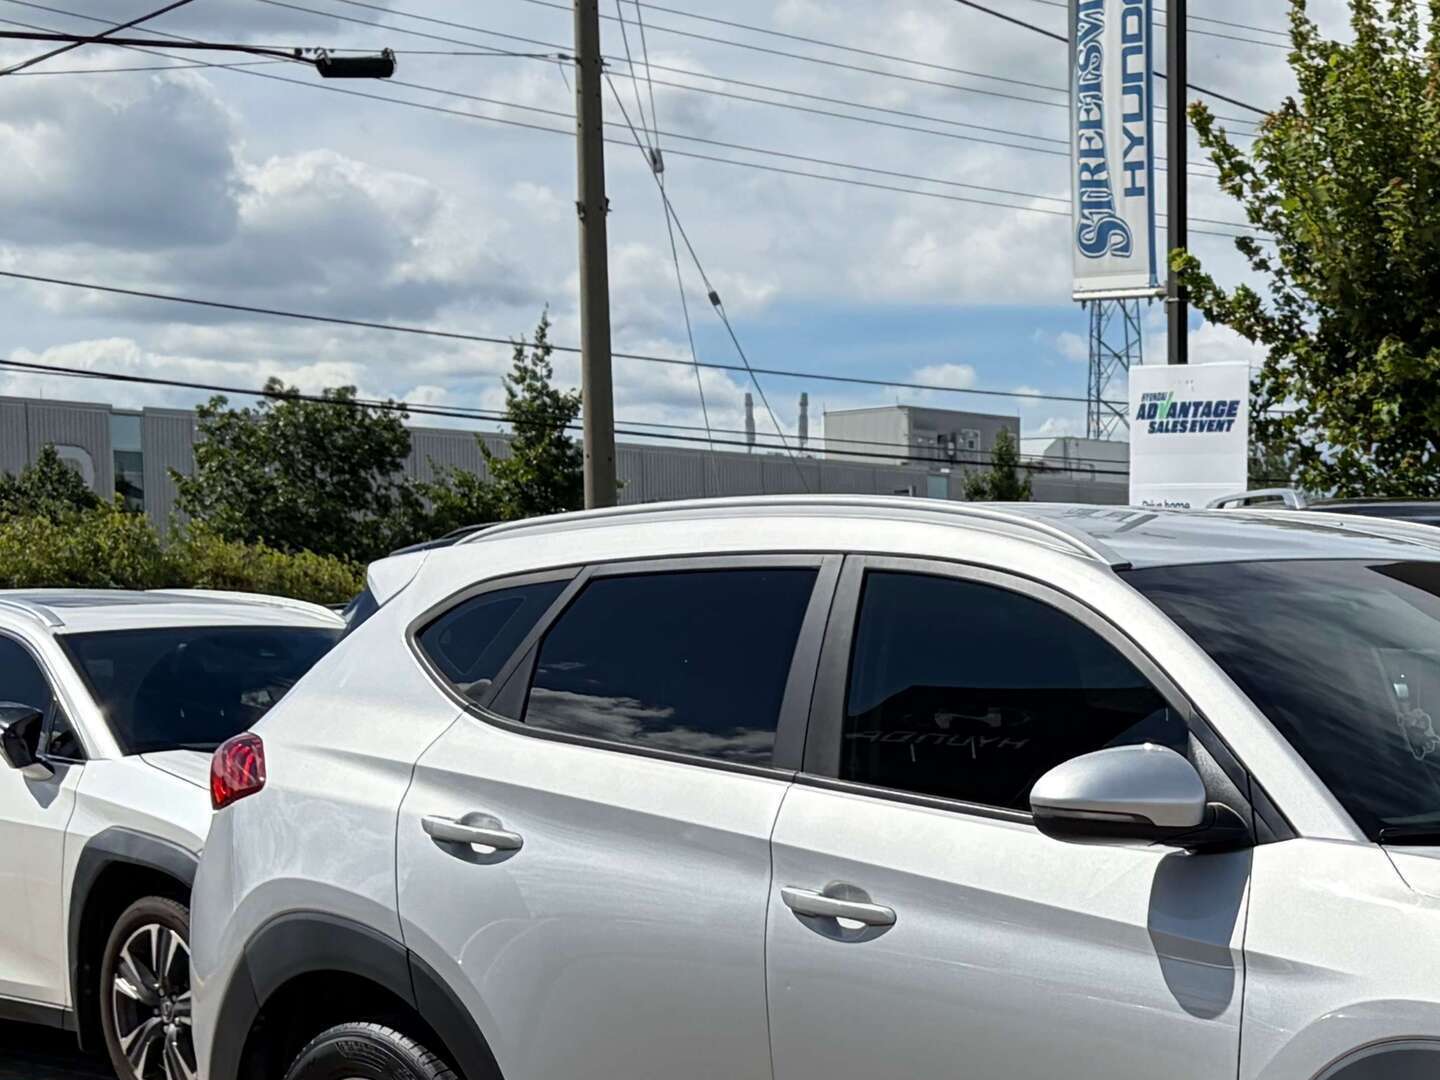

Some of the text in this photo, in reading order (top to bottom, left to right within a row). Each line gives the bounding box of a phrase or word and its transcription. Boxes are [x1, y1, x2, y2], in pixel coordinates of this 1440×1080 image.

[1121, 0, 1146, 198] HYUND
[1136, 393, 1240, 420] ADVANTAGE
[1147, 418, 1235, 434] SALES EVENT
